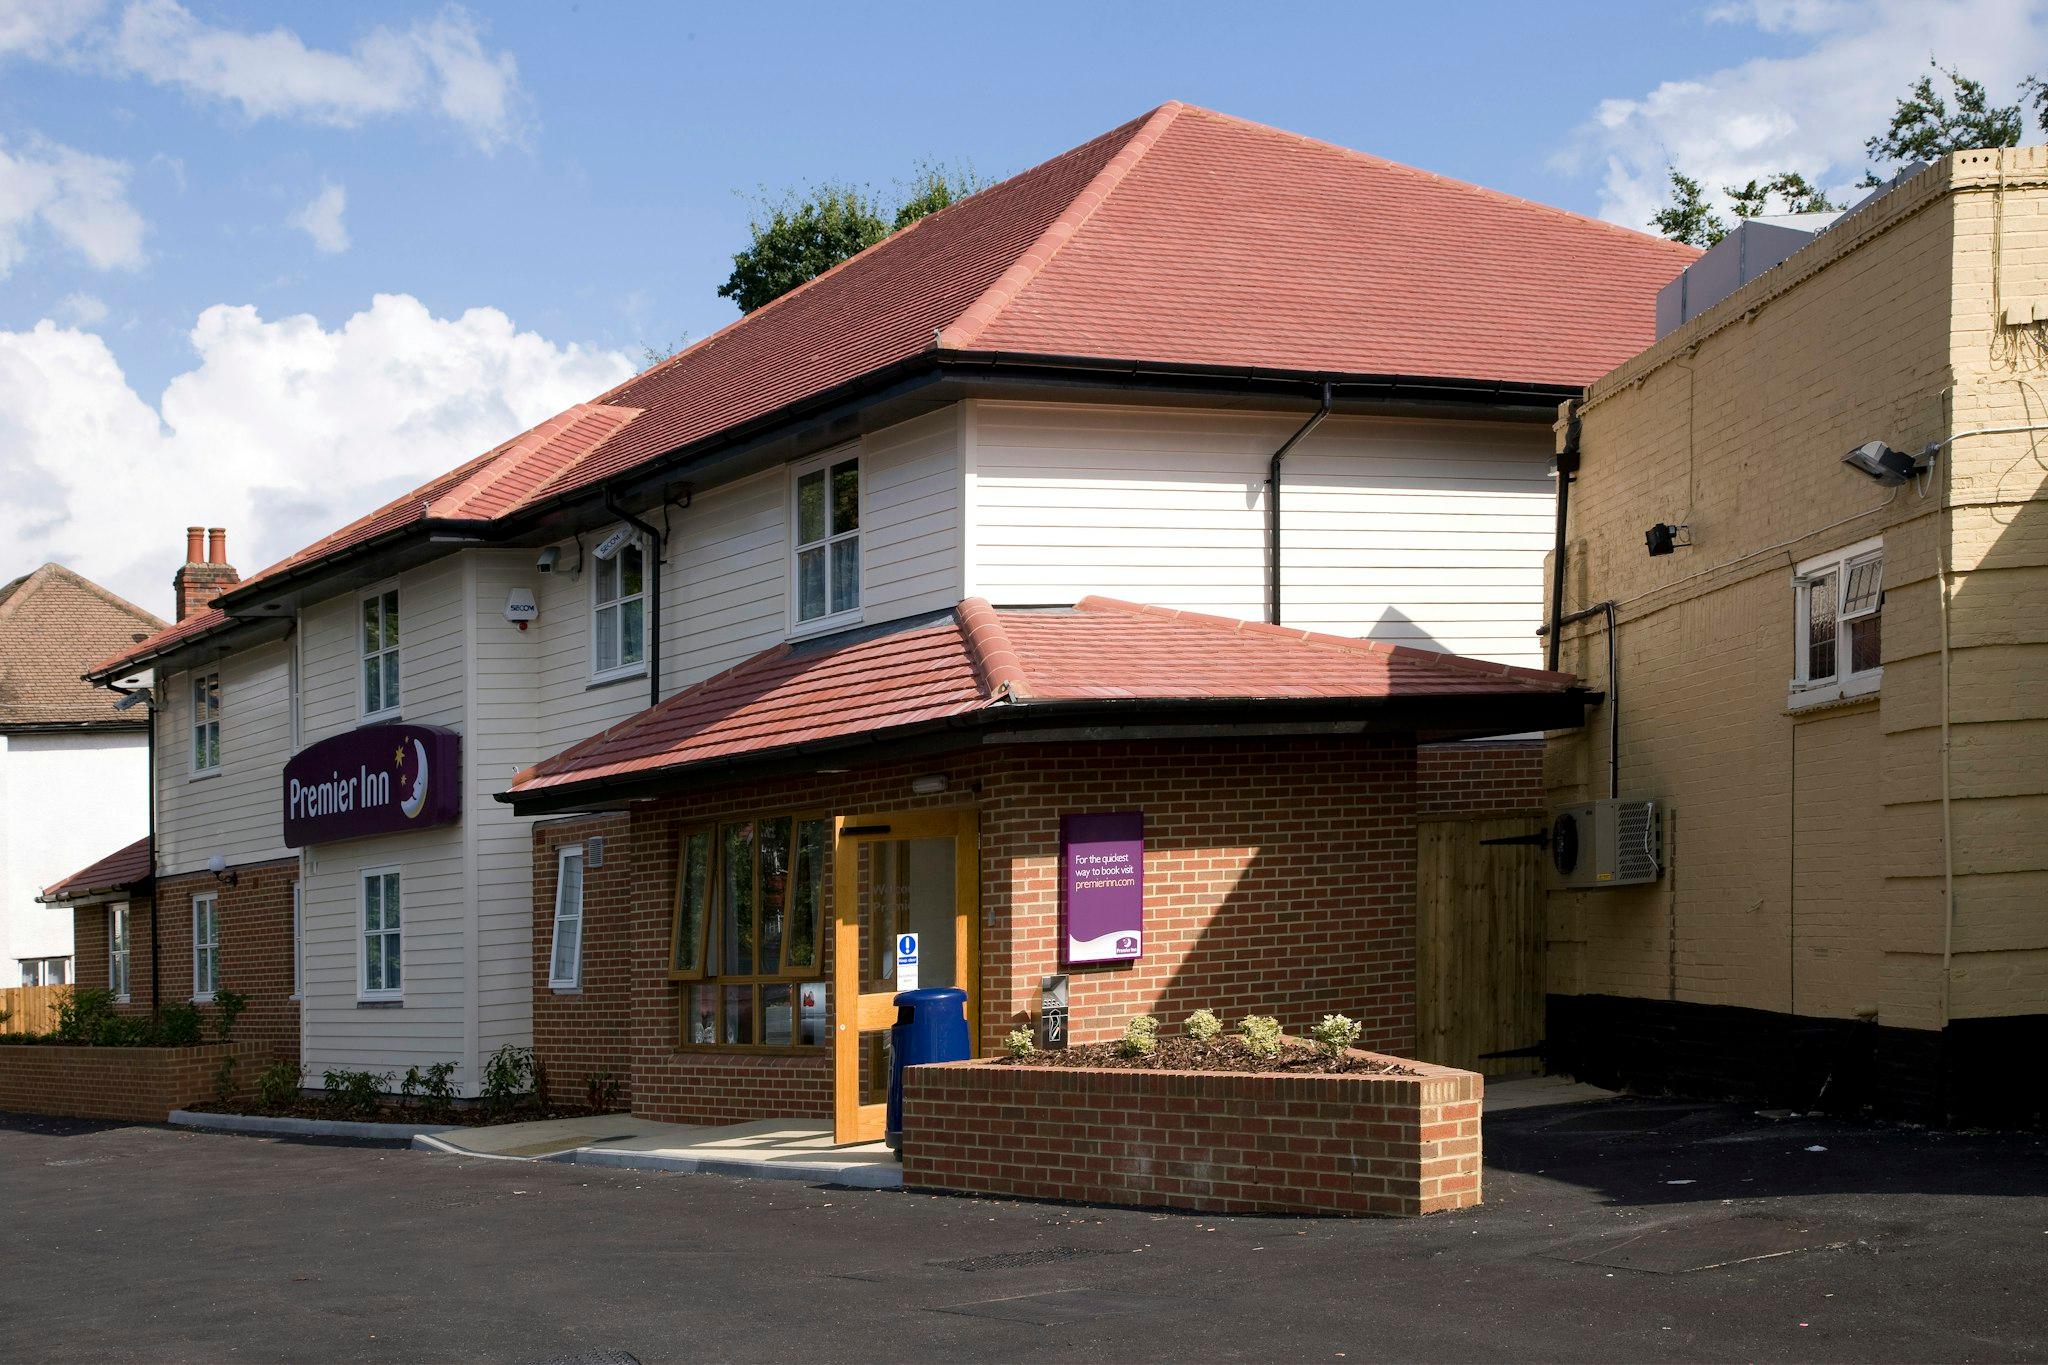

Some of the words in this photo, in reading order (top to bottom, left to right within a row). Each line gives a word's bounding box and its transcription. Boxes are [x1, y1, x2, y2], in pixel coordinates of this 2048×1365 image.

[290, 771, 358, 820] Premier
[361, 764, 390, 808] Inn
[1075, 855, 1089, 864] For
[1089, 854, 1101, 863] the
[1102, 853, 1129, 865] quickest
[1075, 869, 1090, 878] way
[1101, 866, 1120, 875] book
[1121, 865, 1134, 873] visit
[1075, 878, 1135, 891] premierinn.com
